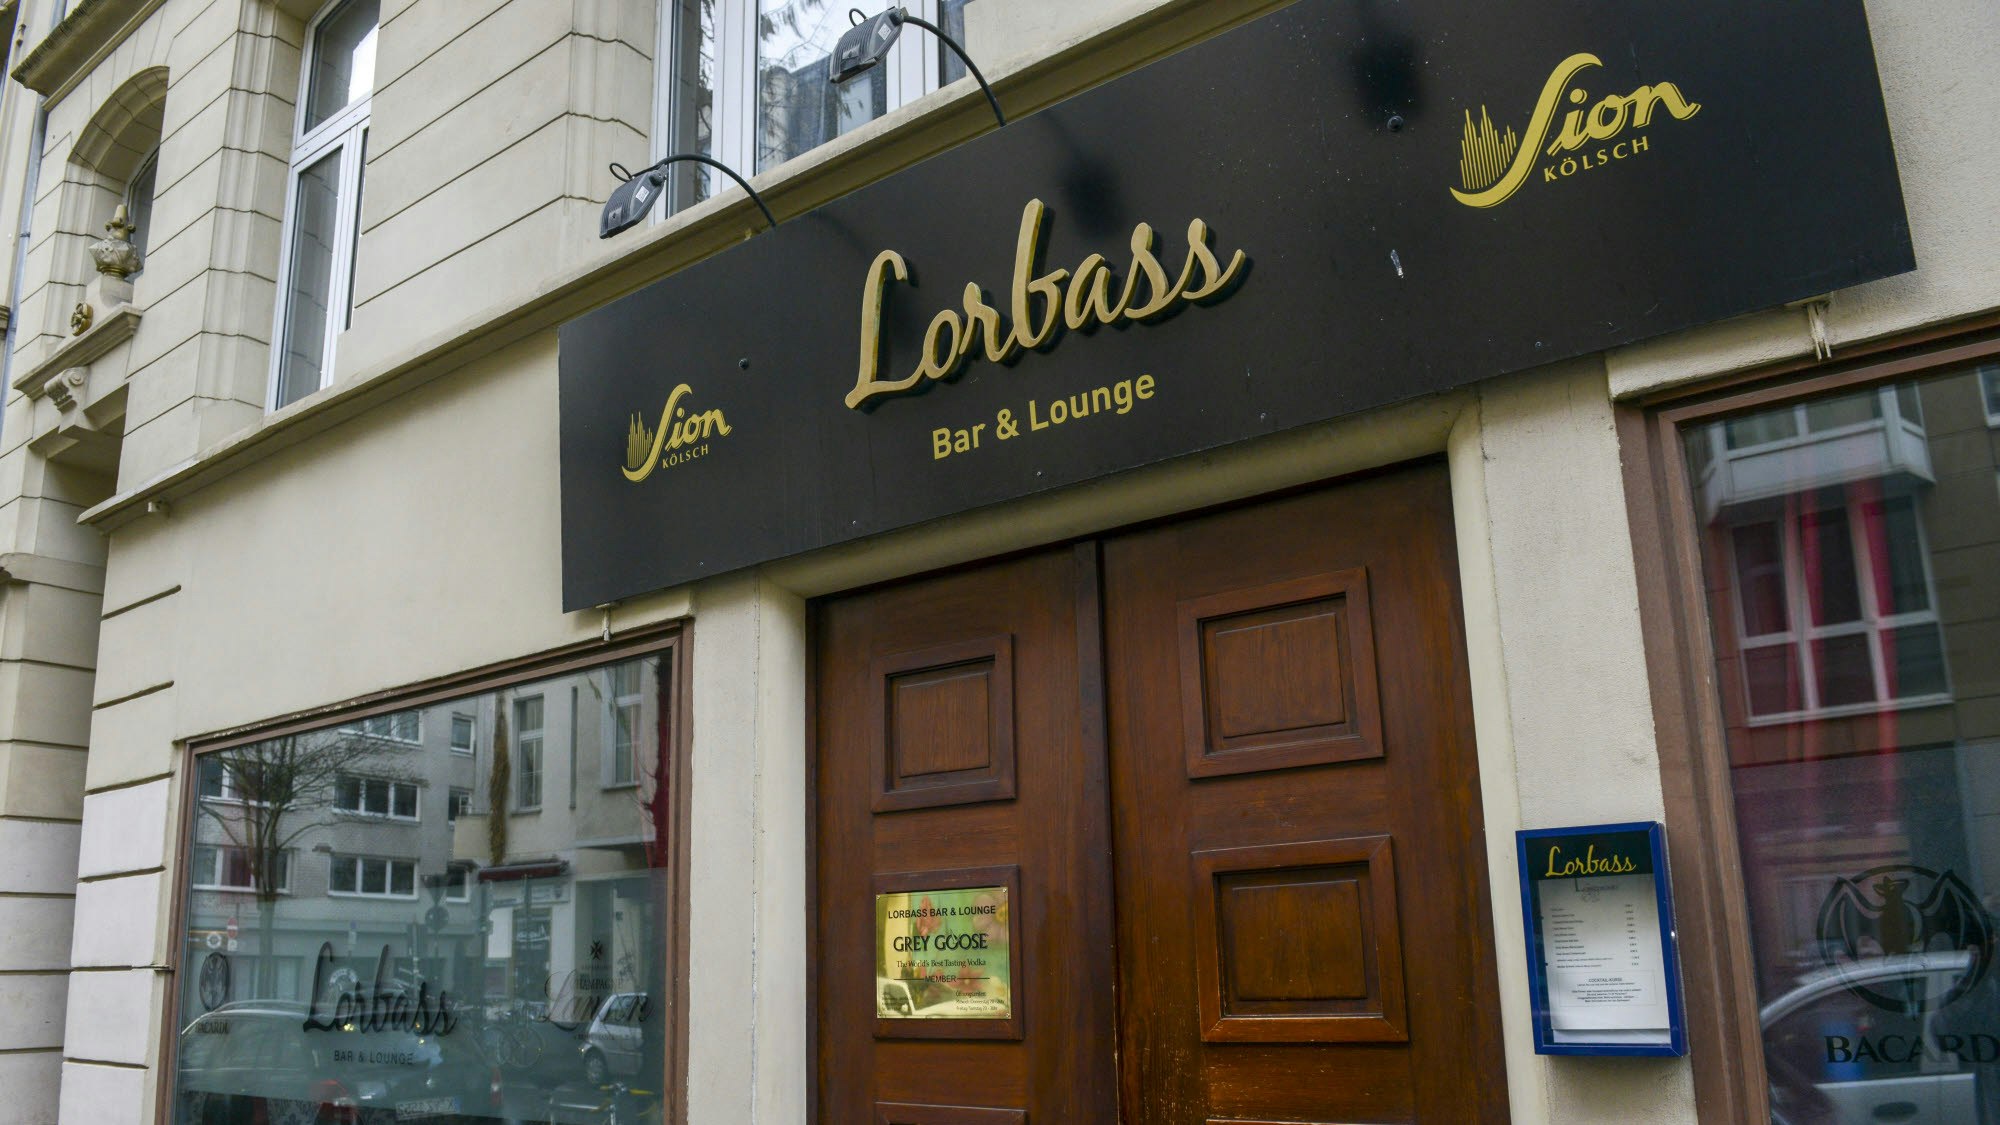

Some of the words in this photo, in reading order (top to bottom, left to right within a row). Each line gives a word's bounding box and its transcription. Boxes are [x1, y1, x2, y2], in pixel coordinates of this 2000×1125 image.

[1450, 52, 1701, 208] Sion
[1543, 136, 1650, 182] KÖLSCH
[844, 197, 1247, 410] Lorbass
[932, 422, 986, 460] Bar
[996, 408, 1020, 441] &
[1029, 374, 1156, 432] Lounge
[621, 383, 733, 482] Sion
[662, 444, 709, 469] KÖLSCH
[1545, 844, 1637, 877] Lorbass
[888, 908, 928, 919] LORBASS
[929, 907, 948, 917] BAR
[950, 907, 957, 916] &
[958, 905, 997, 916] LOUNGE
[893, 935, 931, 952] GREY
[934, 932, 989, 951] GOOSE
[897, 960, 908, 968] The
[907, 959, 930, 968] World's
[931, 959, 943, 967] Best
[944, 959, 967, 969] Tasting
[967, 958, 987, 967] Vodka
[303, 941, 459, 1037] Lorbass
[575, 976, 624, 992] HAMPAGNE
[924, 974, 957, 983] MEMBER
[333, 1050, 354, 1062] BAR
[358, 1051, 364, 1063] &
[369, 1051, 415, 1065] LOUNGE
